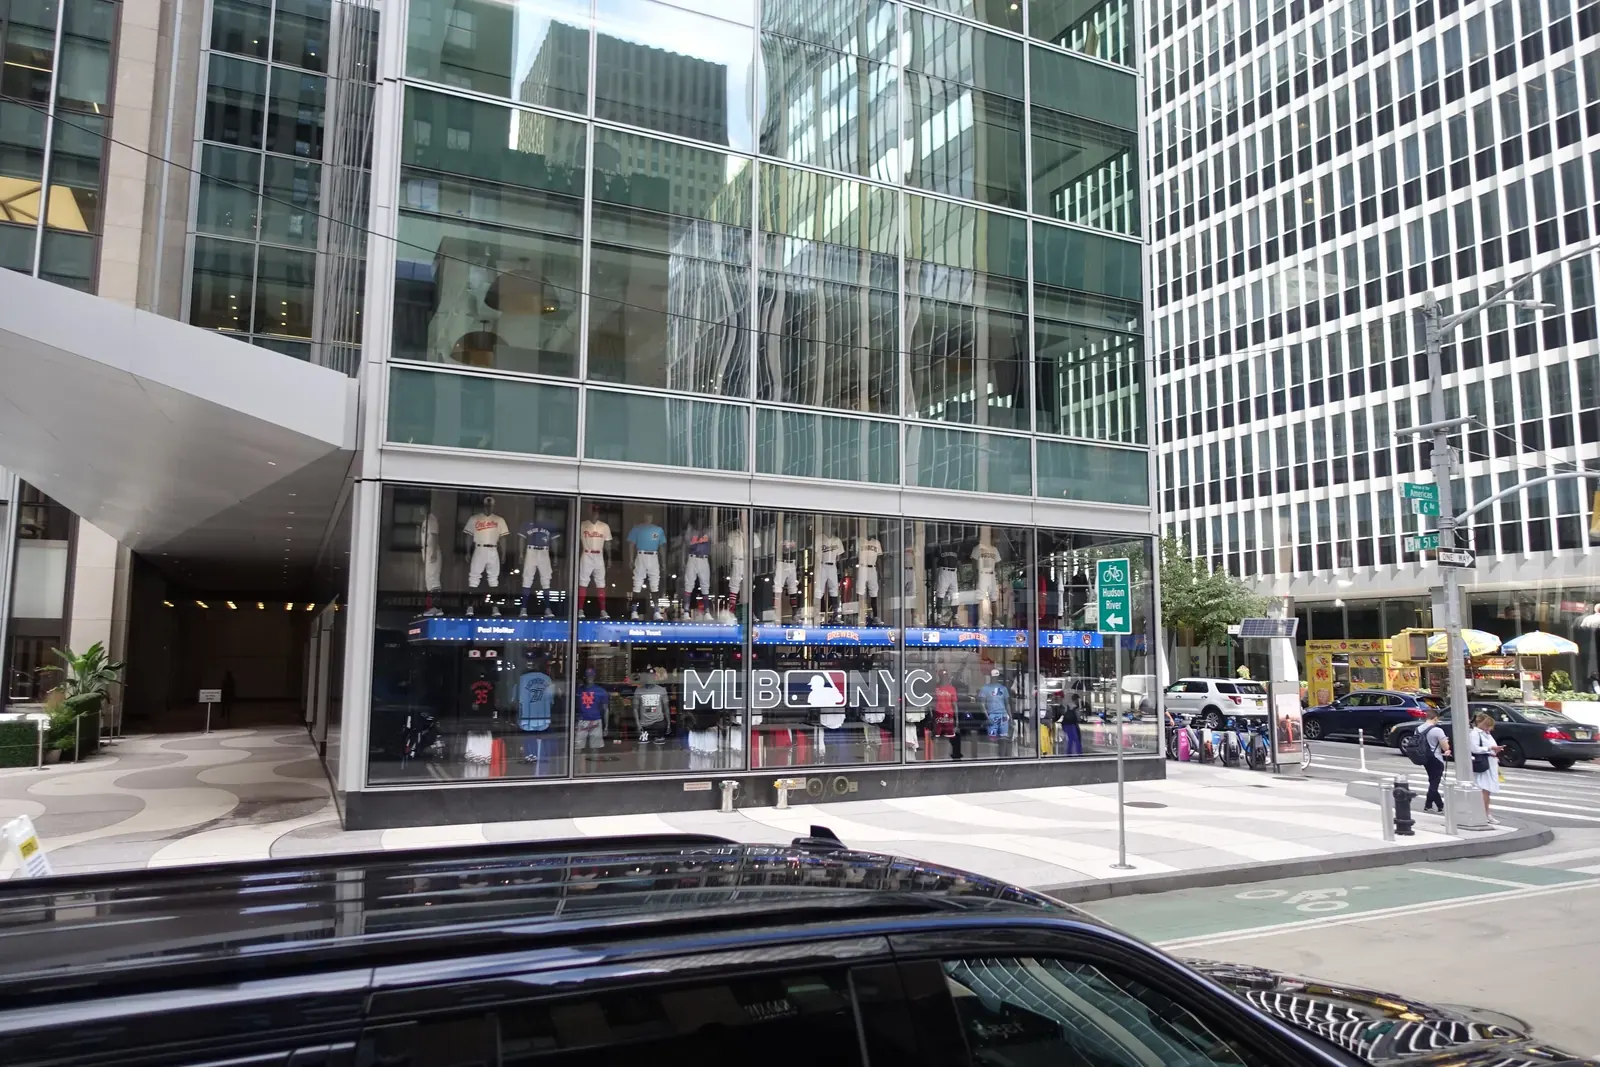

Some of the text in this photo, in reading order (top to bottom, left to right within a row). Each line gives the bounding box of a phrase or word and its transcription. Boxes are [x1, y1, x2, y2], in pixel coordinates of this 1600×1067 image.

[1410, 489, 1433, 499] Americas
[1423, 502, 1428, 513] 6
[1414, 537, 1420, 549] W
[1423, 536, 1431, 549] 51
[1443, 553, 1470, 562] ONE WAY
[1102, 588, 1125, 597] Hudson
[1105, 600, 1122, 610] River
[477, 626, 515, 635] Paul Molitor
[826, 630, 861, 642] BREWERS
[958, 632, 989, 644] BREWERS
[683, 668, 933, 710] MLB NYC
